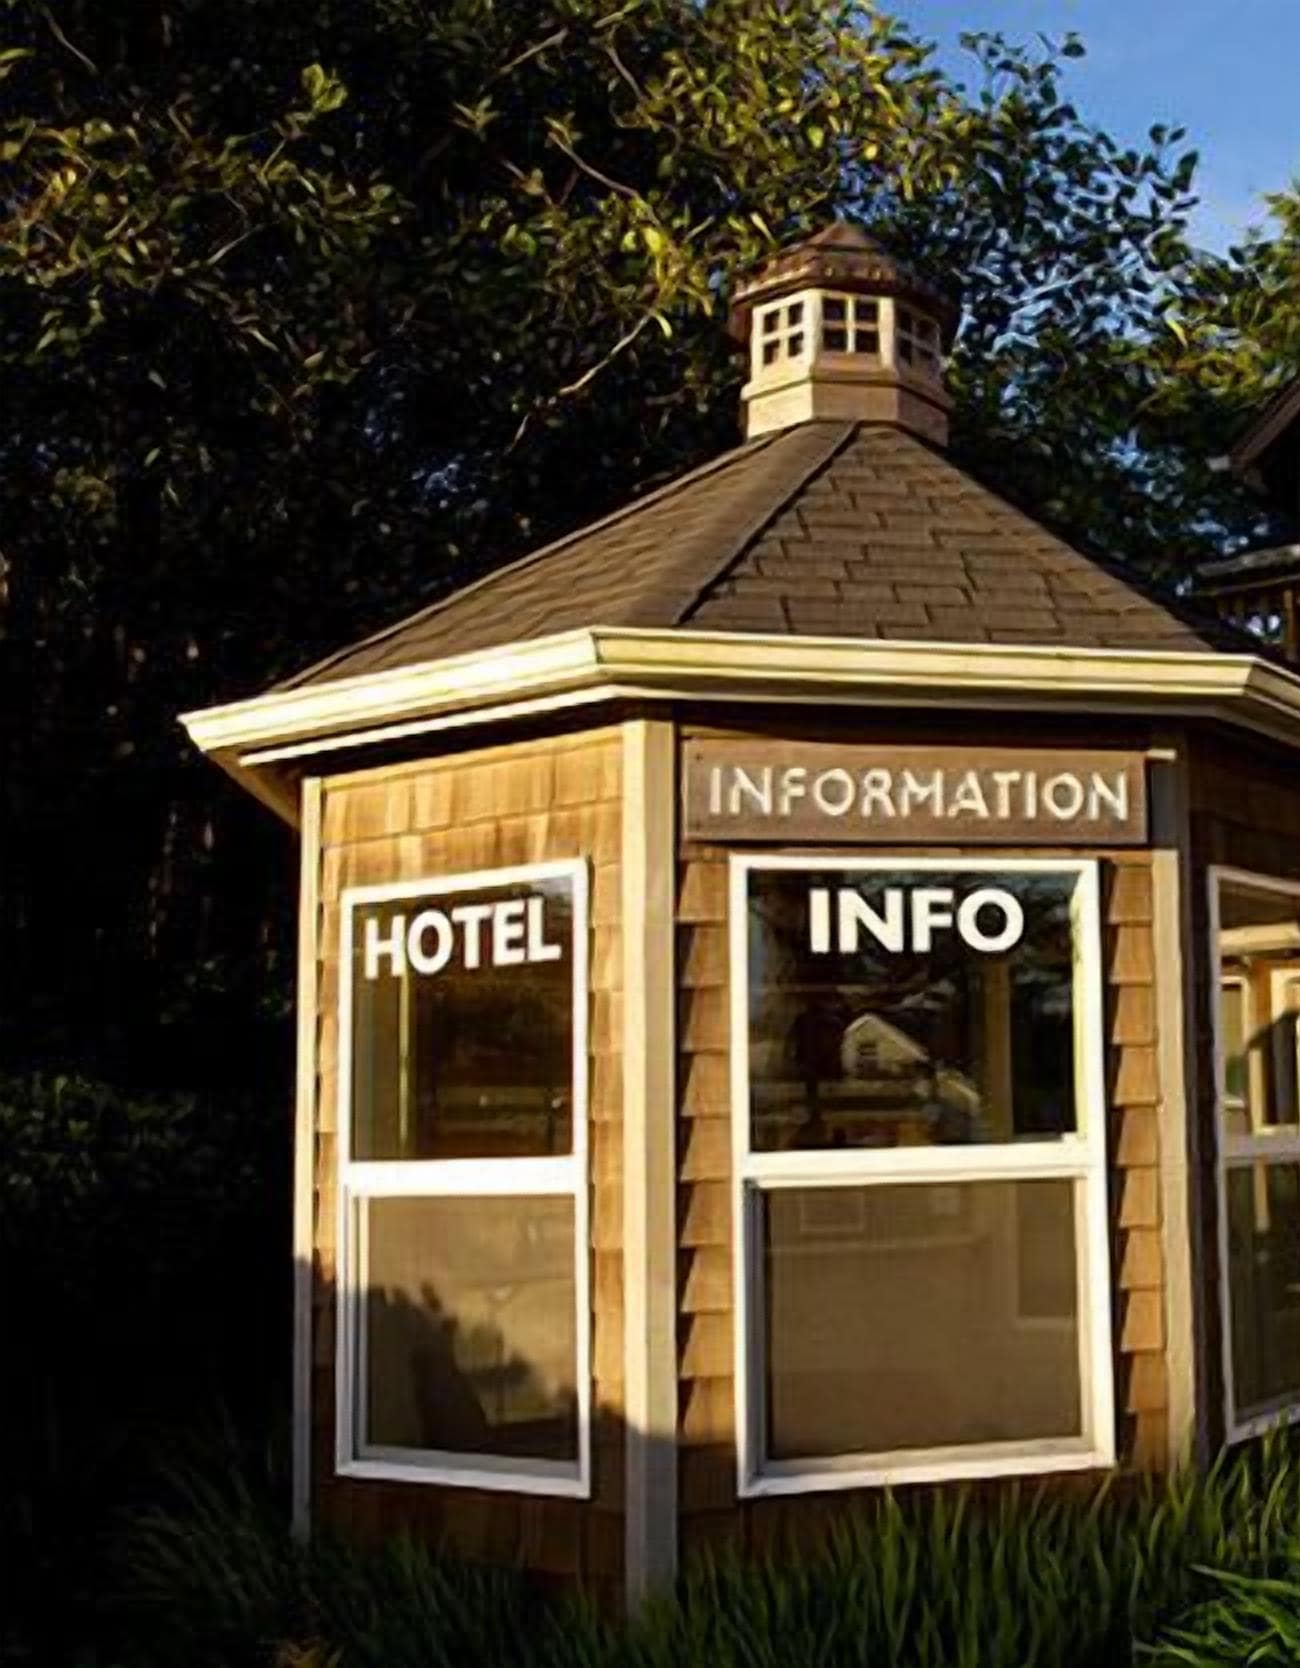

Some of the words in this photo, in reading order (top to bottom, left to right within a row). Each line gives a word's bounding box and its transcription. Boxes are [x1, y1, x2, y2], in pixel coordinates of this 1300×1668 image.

[708, 766, 1129, 822] INFORMATION
[364, 896, 562, 980] HOTEL
[809, 887, 1025, 954] INFO
